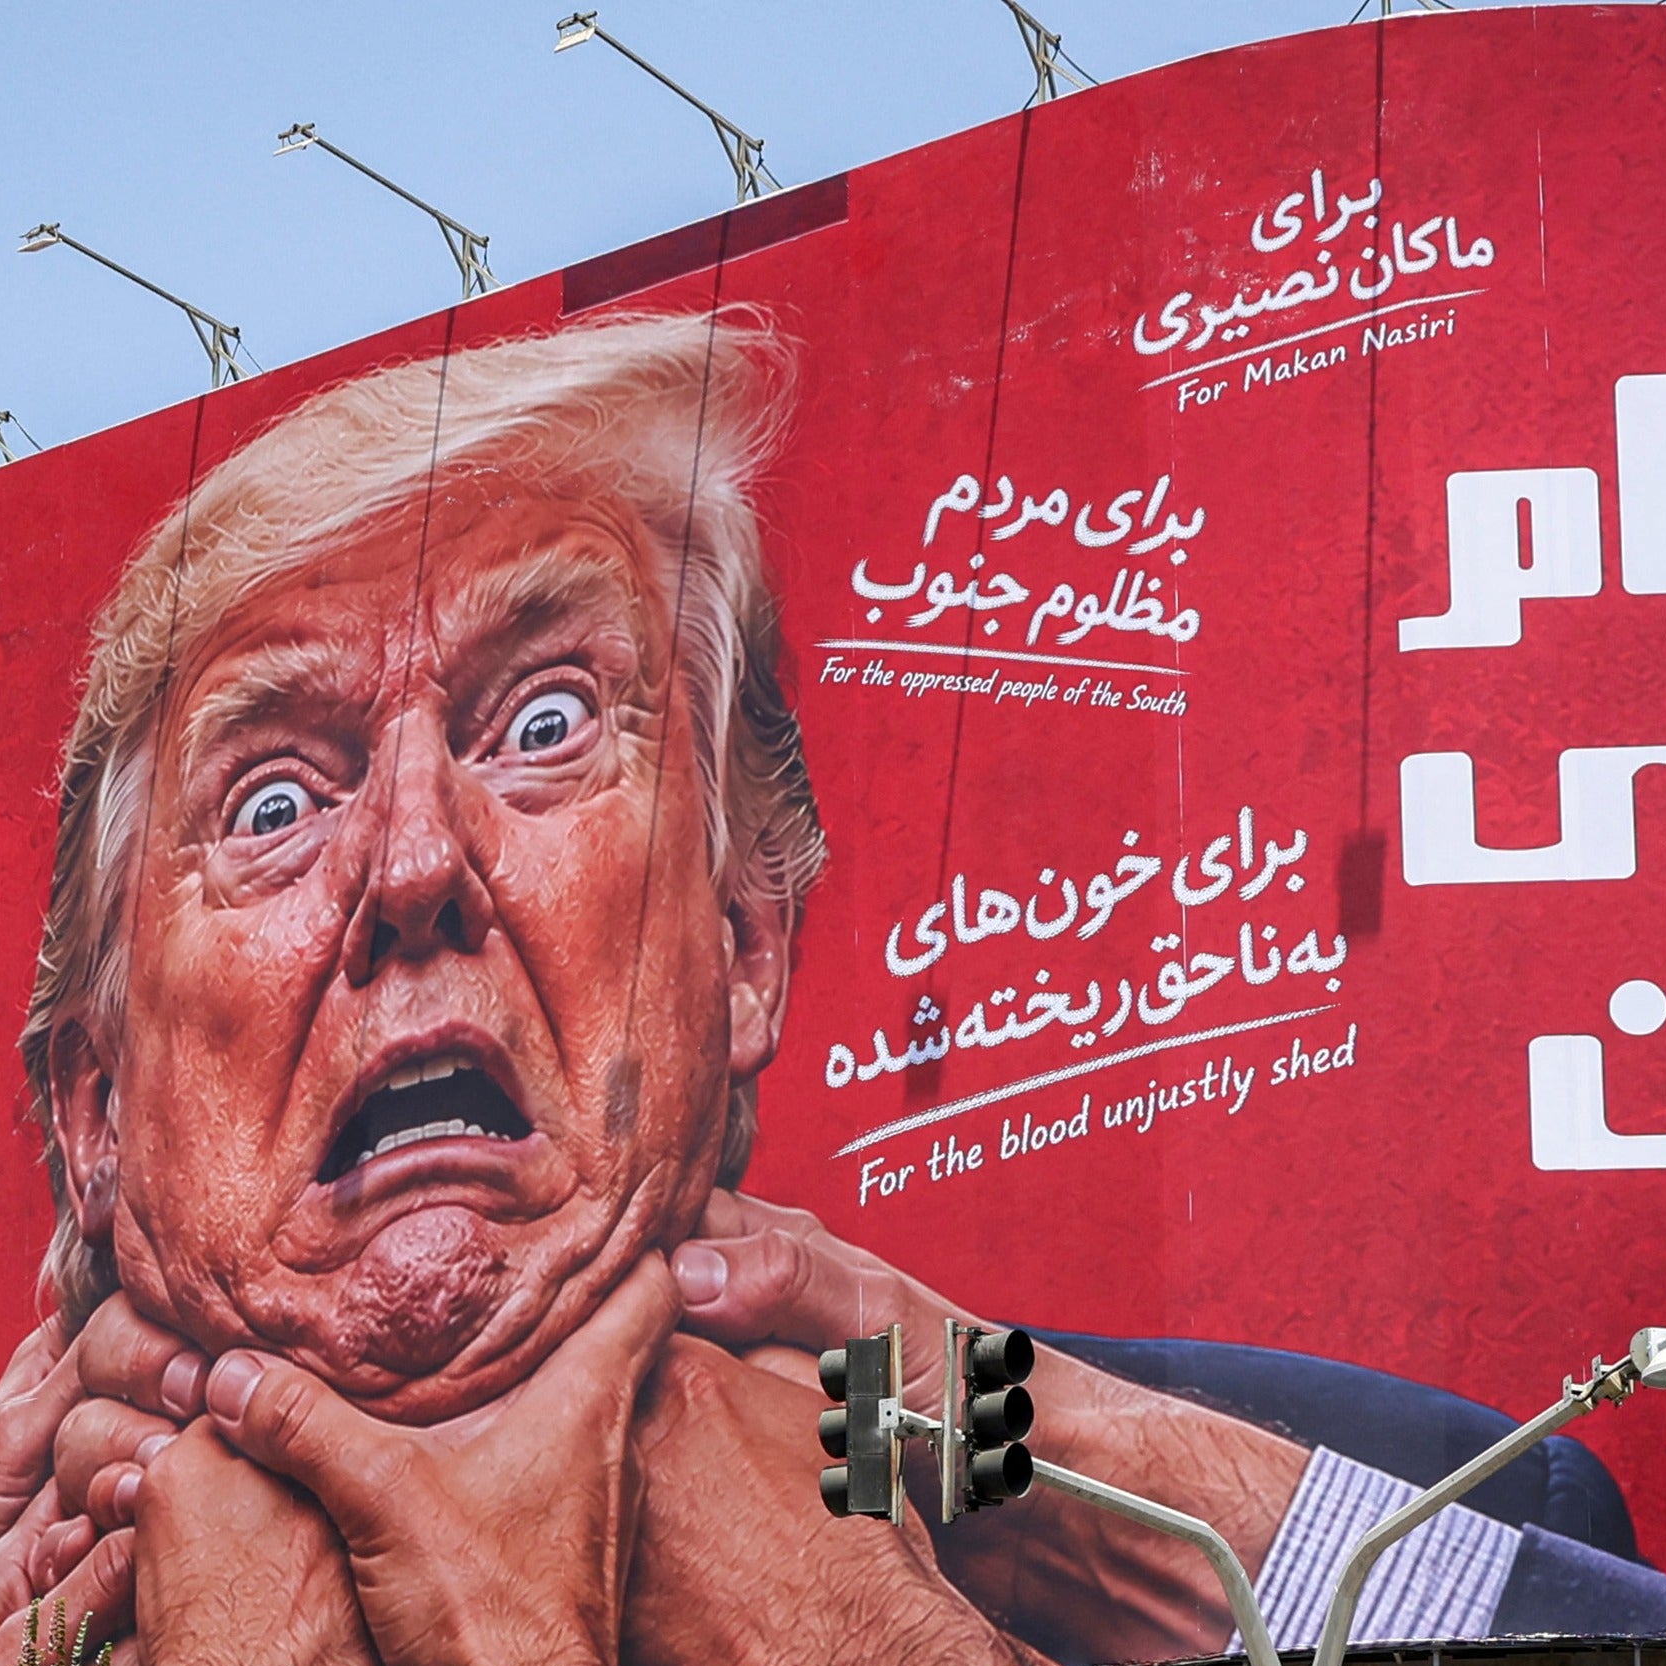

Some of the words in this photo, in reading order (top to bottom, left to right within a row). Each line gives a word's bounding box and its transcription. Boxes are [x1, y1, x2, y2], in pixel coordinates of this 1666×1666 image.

[1251, 168, 1382, 252] برای
[1350, 215, 1494, 300] ماکان
[1133, 250, 1339, 355] نصیری
[1178, 378, 1228, 412] For
[1244, 346, 1346, 392] Makan
[1362, 309, 1455, 356] Nasiri
[923, 474, 1069, 547] مردم
[1074, 474, 1205, 566] برای
[852, 553, 1030, 635] جنوب
[1026, 568, 1200, 646] مظلوم
[820, 656, 857, 683] For
[862, 659, 895, 686] the
[900, 669, 999, 697] oppressed
[995, 674, 1058, 707] people
[1063, 677, 1091, 705] of
[1090, 681, 1122, 707] the
[1126, 684, 1186, 716] South
[859, 1157, 915, 1206] For
[926, 1135, 983, 1181] the
[1000, 1094, 1090, 1160] blood
[1104, 1054, 1255, 1133] unjustly
[1271, 1023, 1357, 1085] shed
